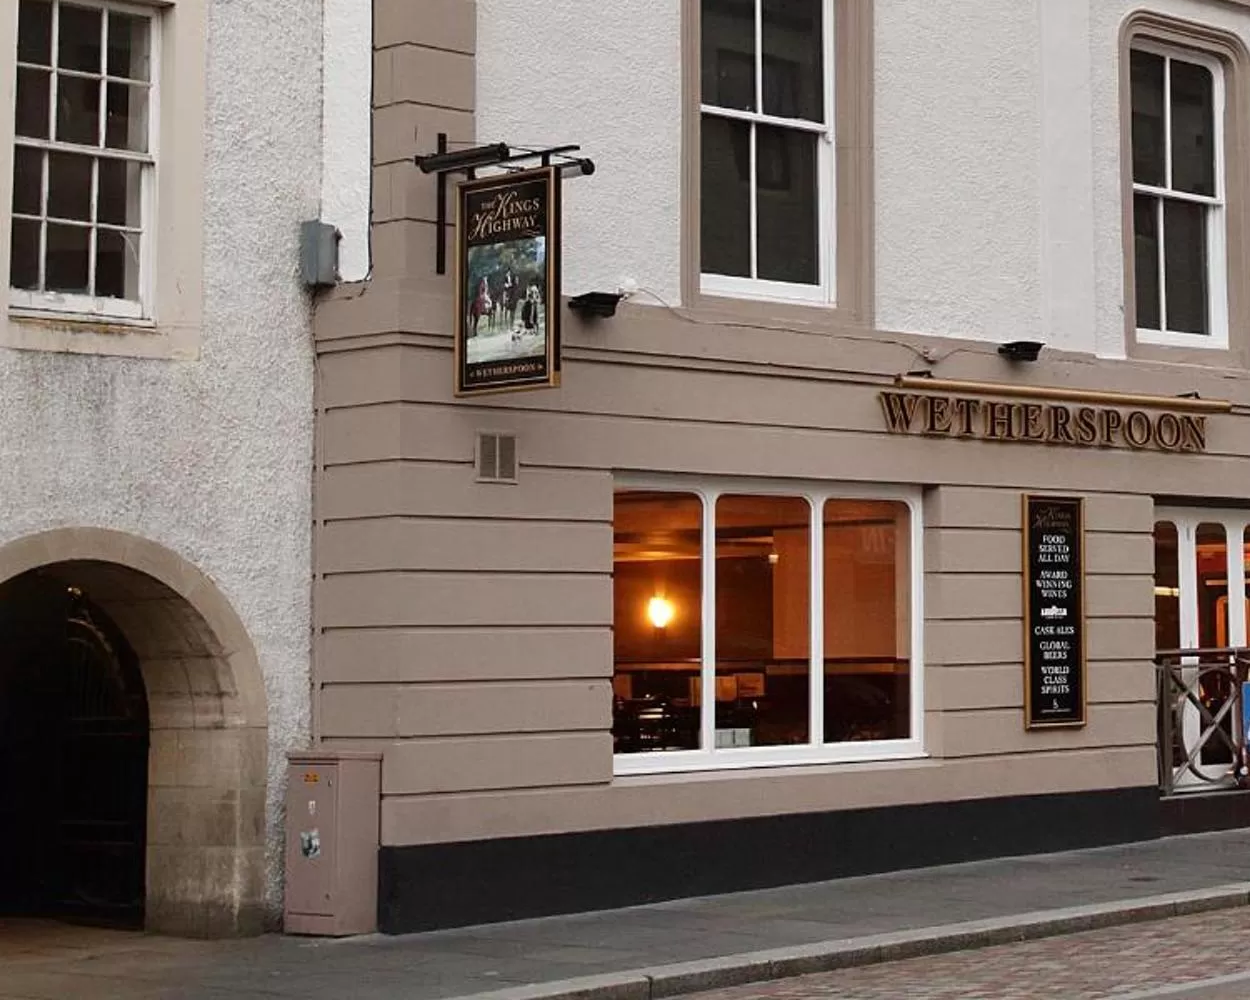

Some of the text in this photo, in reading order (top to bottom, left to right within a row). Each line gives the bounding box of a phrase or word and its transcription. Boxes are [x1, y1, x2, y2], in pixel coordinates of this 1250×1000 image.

[494, 191, 540, 220] KINGS
[468, 211, 537, 240] HIGHWAY
[880, 391, 1208, 450] WETHERSPOON
[1042, 534, 1066, 544] FOOD
[1034, 625, 1055, 636] CASK
